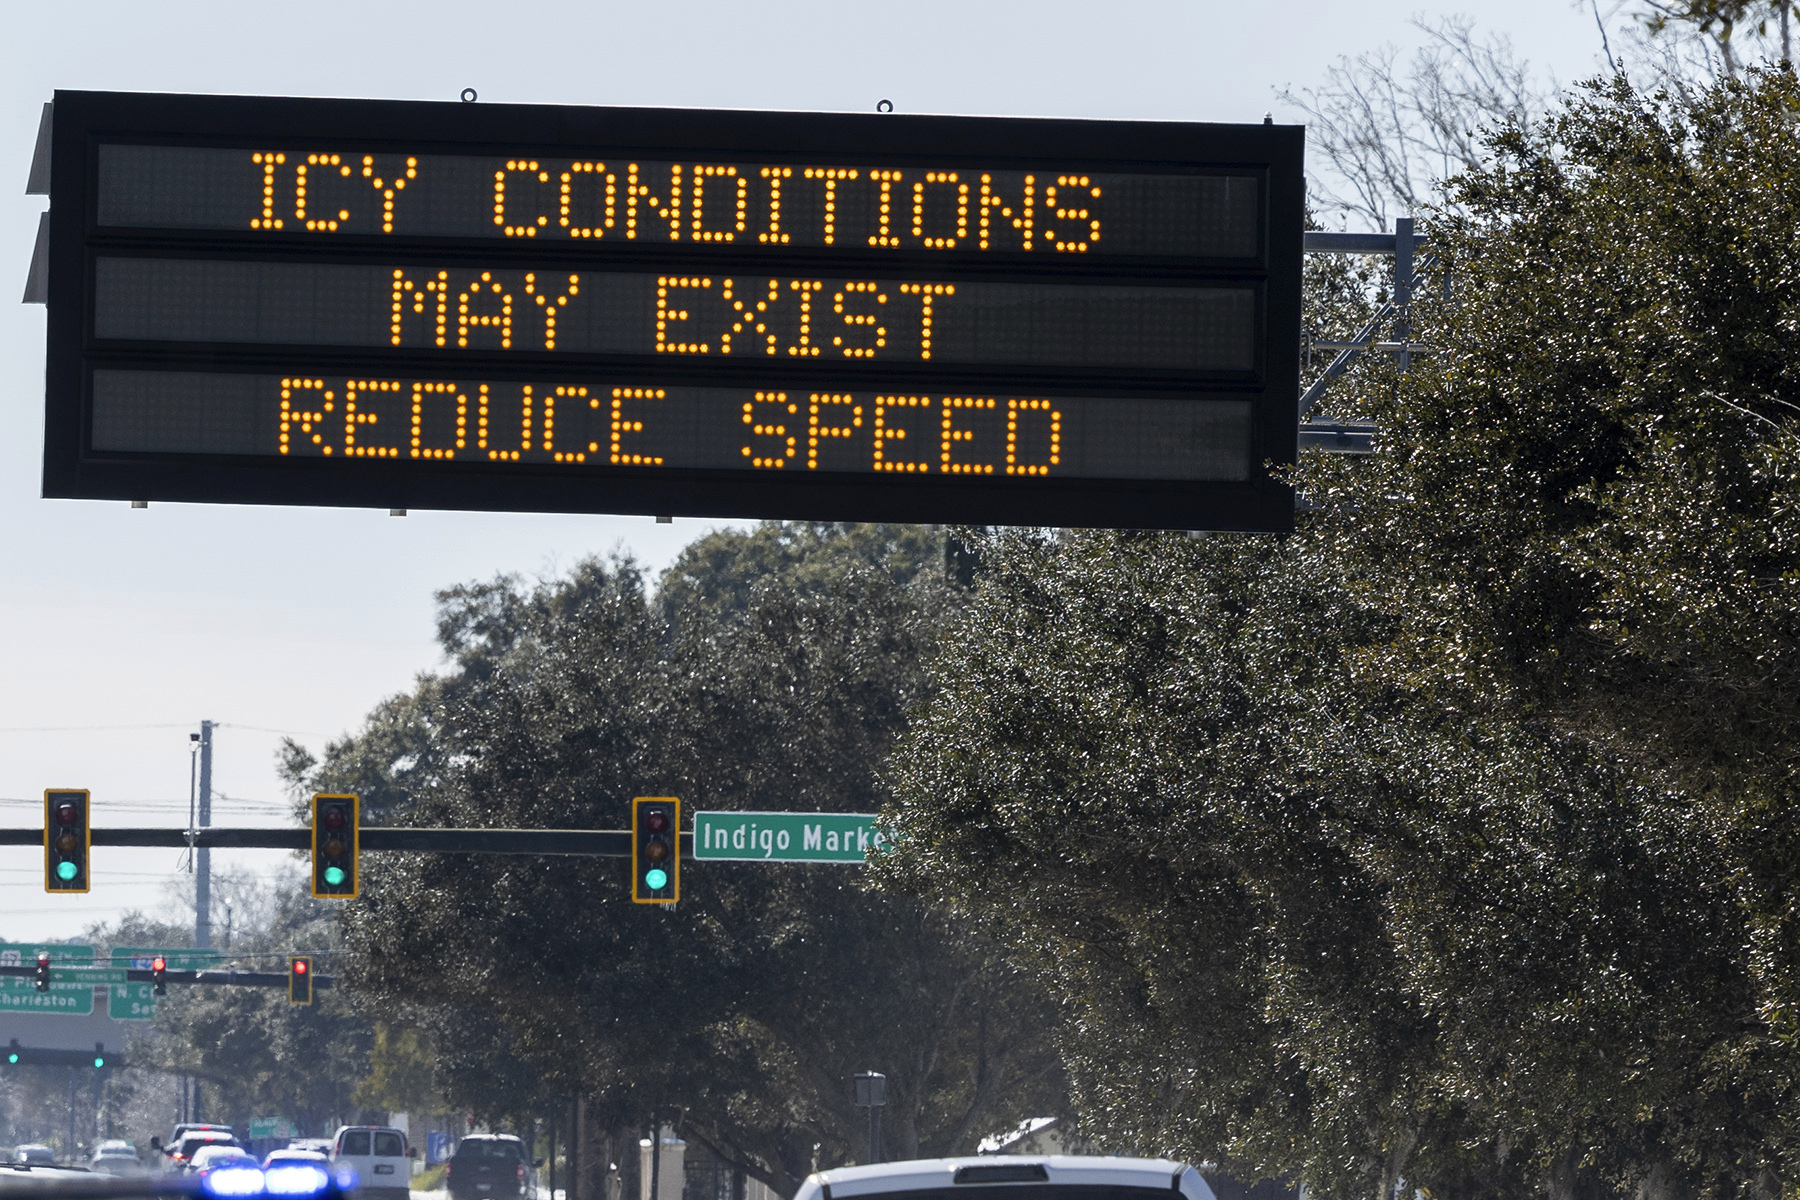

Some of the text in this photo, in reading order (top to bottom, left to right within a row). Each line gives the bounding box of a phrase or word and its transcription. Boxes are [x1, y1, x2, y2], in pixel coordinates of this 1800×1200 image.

[250, 151, 1101, 252] ICY CONDITIONS
[390, 268, 955, 360] MAY EXIST
[279, 378, 1061, 475] REDUCE SPEED
[704, 822, 791, 858] Indigo
